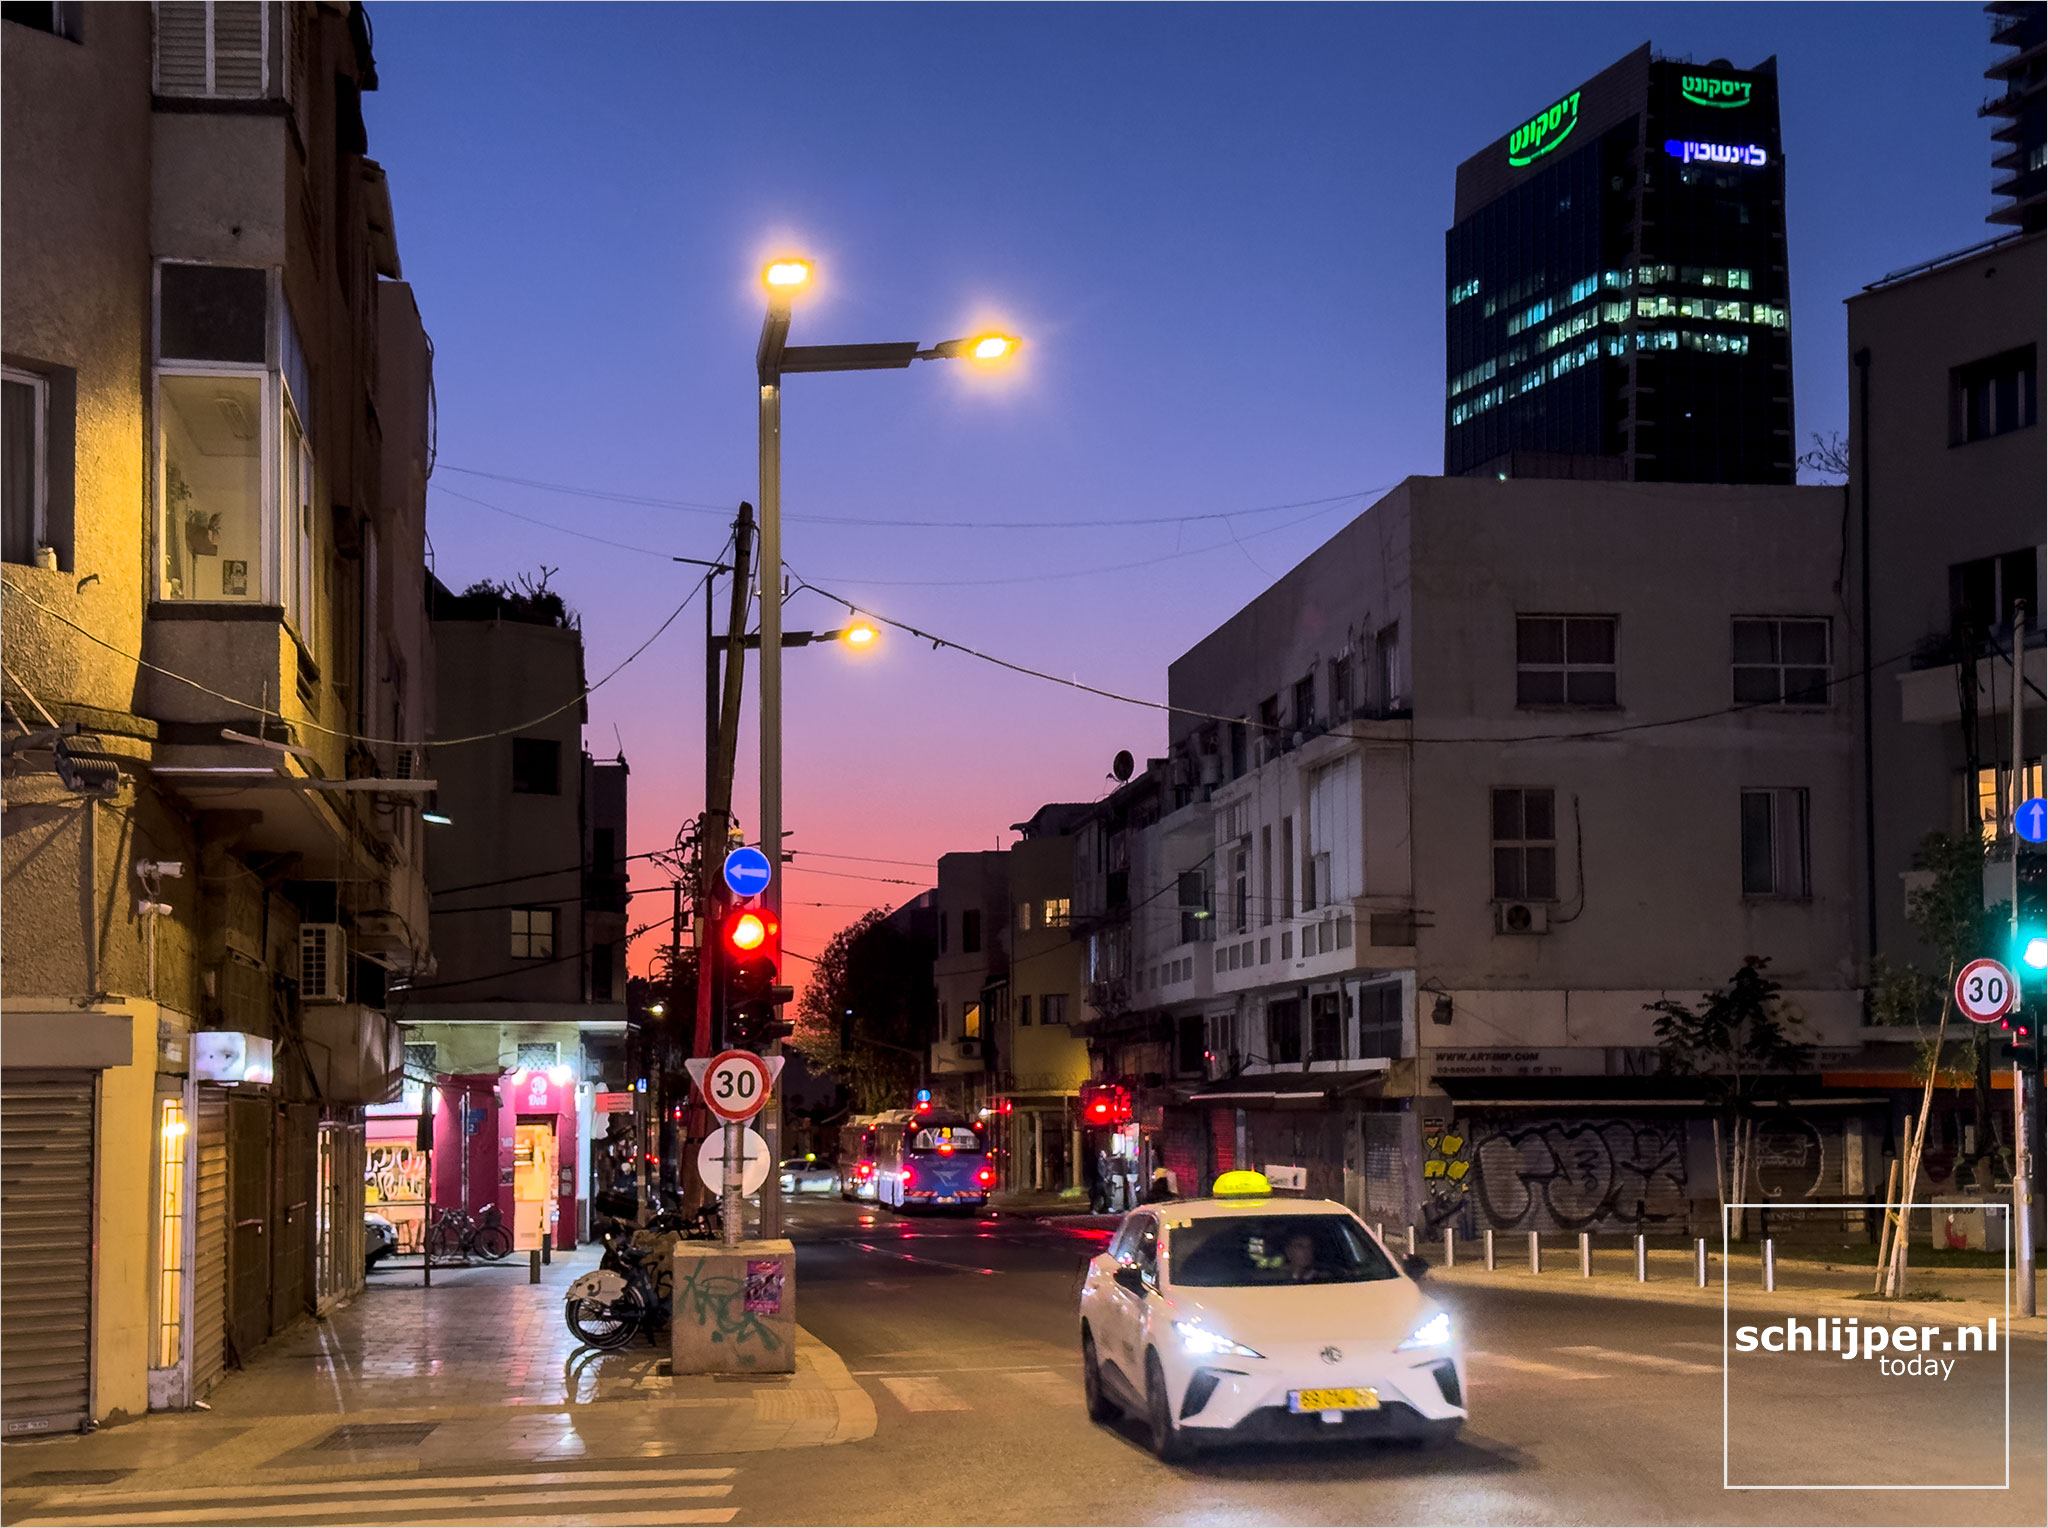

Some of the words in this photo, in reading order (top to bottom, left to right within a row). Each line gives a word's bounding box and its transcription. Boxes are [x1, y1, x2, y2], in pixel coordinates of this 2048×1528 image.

[1682, 75, 1751, 99] דיסקונט
[1509, 91, 1581, 155] דיסקונט
[1968, 976, 2003, 1004] 30
[716, 1070, 755, 1098] 30
